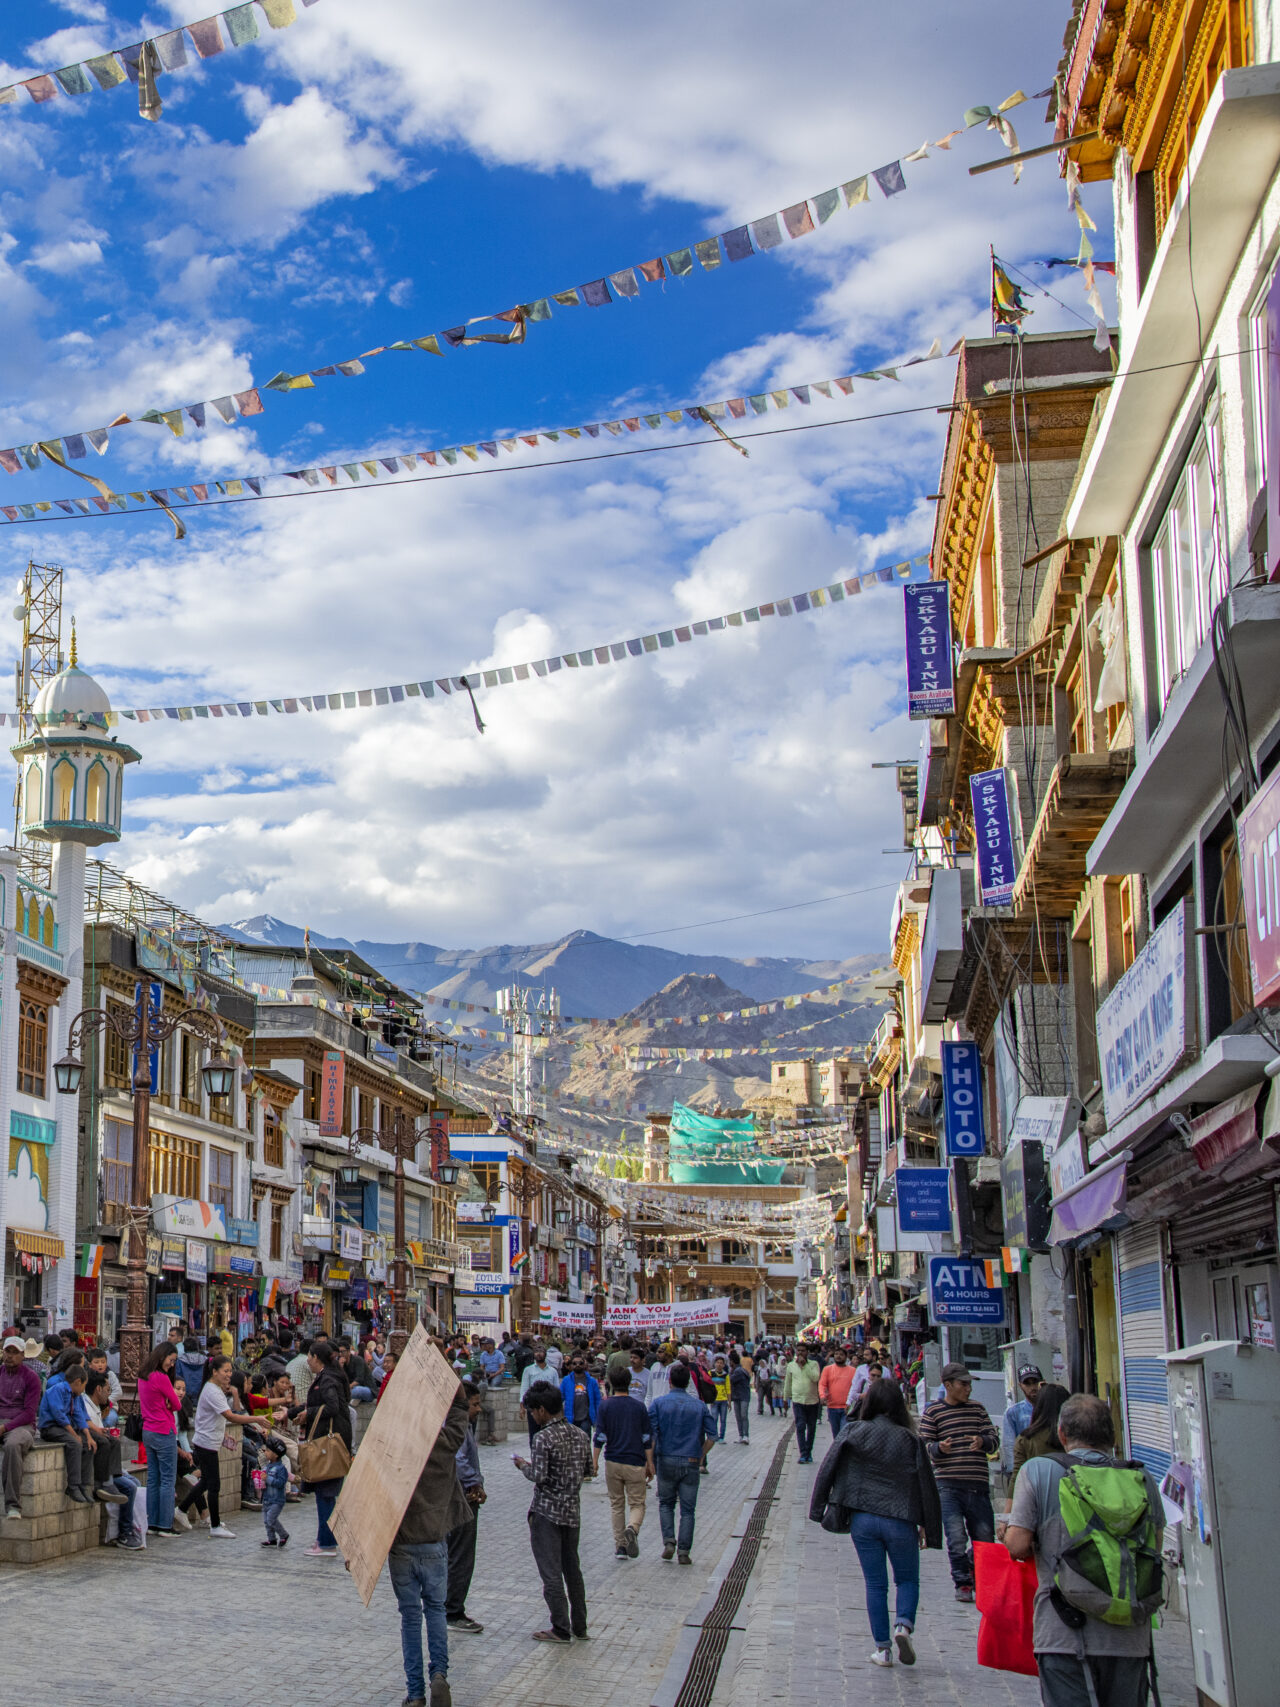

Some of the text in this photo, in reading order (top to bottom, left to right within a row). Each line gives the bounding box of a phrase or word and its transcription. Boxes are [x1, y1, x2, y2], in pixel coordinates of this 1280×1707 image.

[917, 595, 938, 655] SKYABU
[921, 661, 939, 691] INN
[929, 690, 952, 699] Available
[982, 784, 1001, 849] SKYABU
[990, 854, 1005, 887] INN
[327, 1065, 338, 1124] HIMALAYAN
[951, 1047, 977, 1149] PHOTO
[898, 1179, 947, 1188] Foreign Exchange
[475, 1273, 502, 1282] LOTUS
[943, 1290, 990, 1299] 24 HOURS
[606, 1305, 671, 1314] HANK YOU
[950, 1304, 995, 1312] HDFC BANK
[674, 1310, 692, 1318] Minister
[690, 1312, 719, 1321] LADAKH
[1020, 1366, 1038, 1376] NYC
